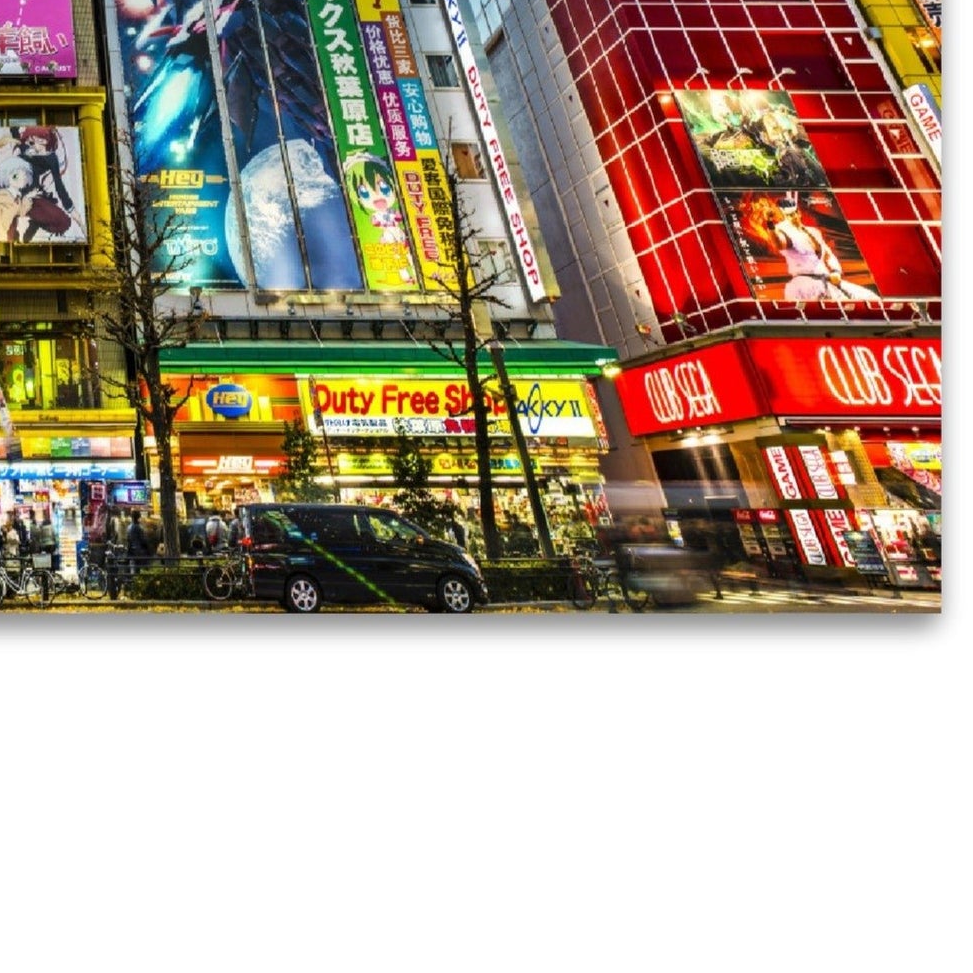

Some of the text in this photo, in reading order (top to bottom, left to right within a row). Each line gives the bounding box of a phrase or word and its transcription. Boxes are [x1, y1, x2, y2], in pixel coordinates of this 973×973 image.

[910, 93, 941, 142] GAME
[468, 66, 539, 286] DUTY FREE SHOP
[316, 385, 375, 415] Duty
[382, 385, 439, 415] Free
[644, 367, 684, 424] CLUB
[674, 359, 722, 420] SEGA
[818, 345, 893, 406] CLUB
